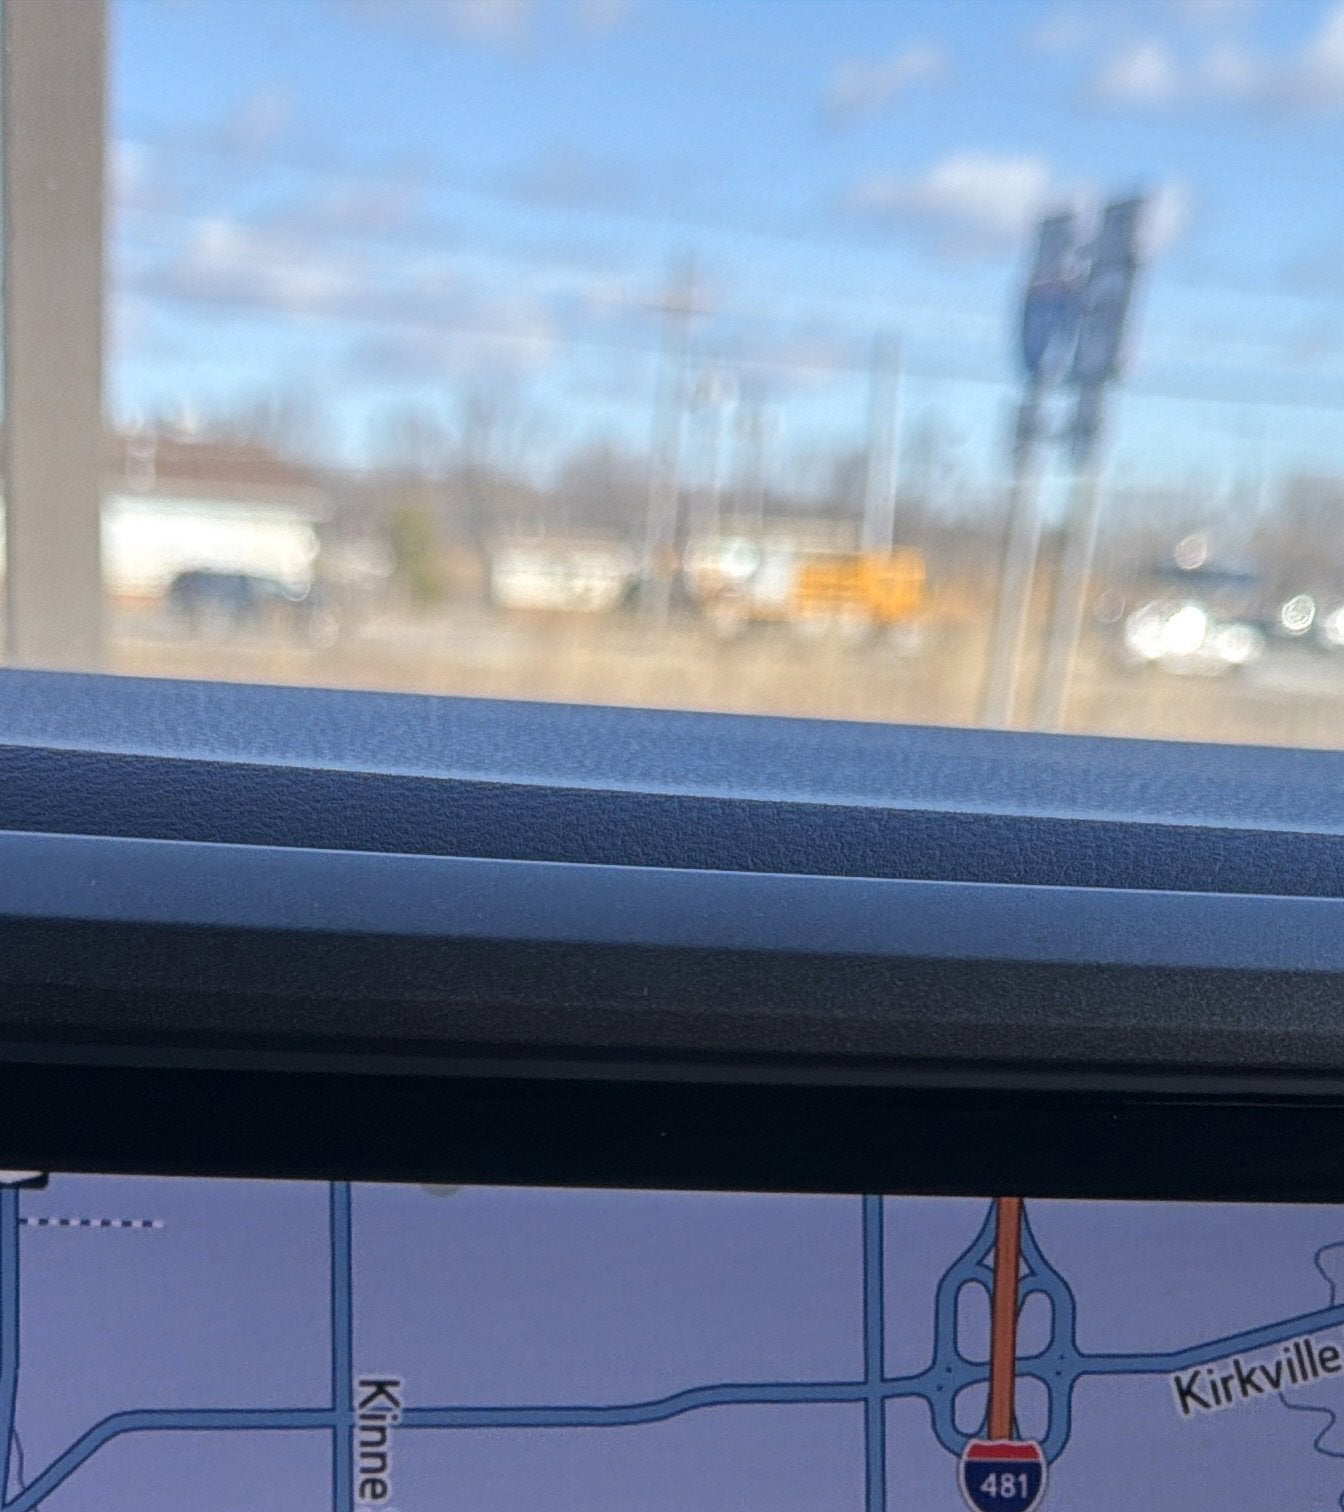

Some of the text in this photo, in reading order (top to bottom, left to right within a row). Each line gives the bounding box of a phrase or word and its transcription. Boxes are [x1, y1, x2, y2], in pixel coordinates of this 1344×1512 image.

[1173, 1336, 1342, 1415] Kirkville
[357, 1378, 402, 1503] Kinne
[979, 1472, 1030, 1500] 481
